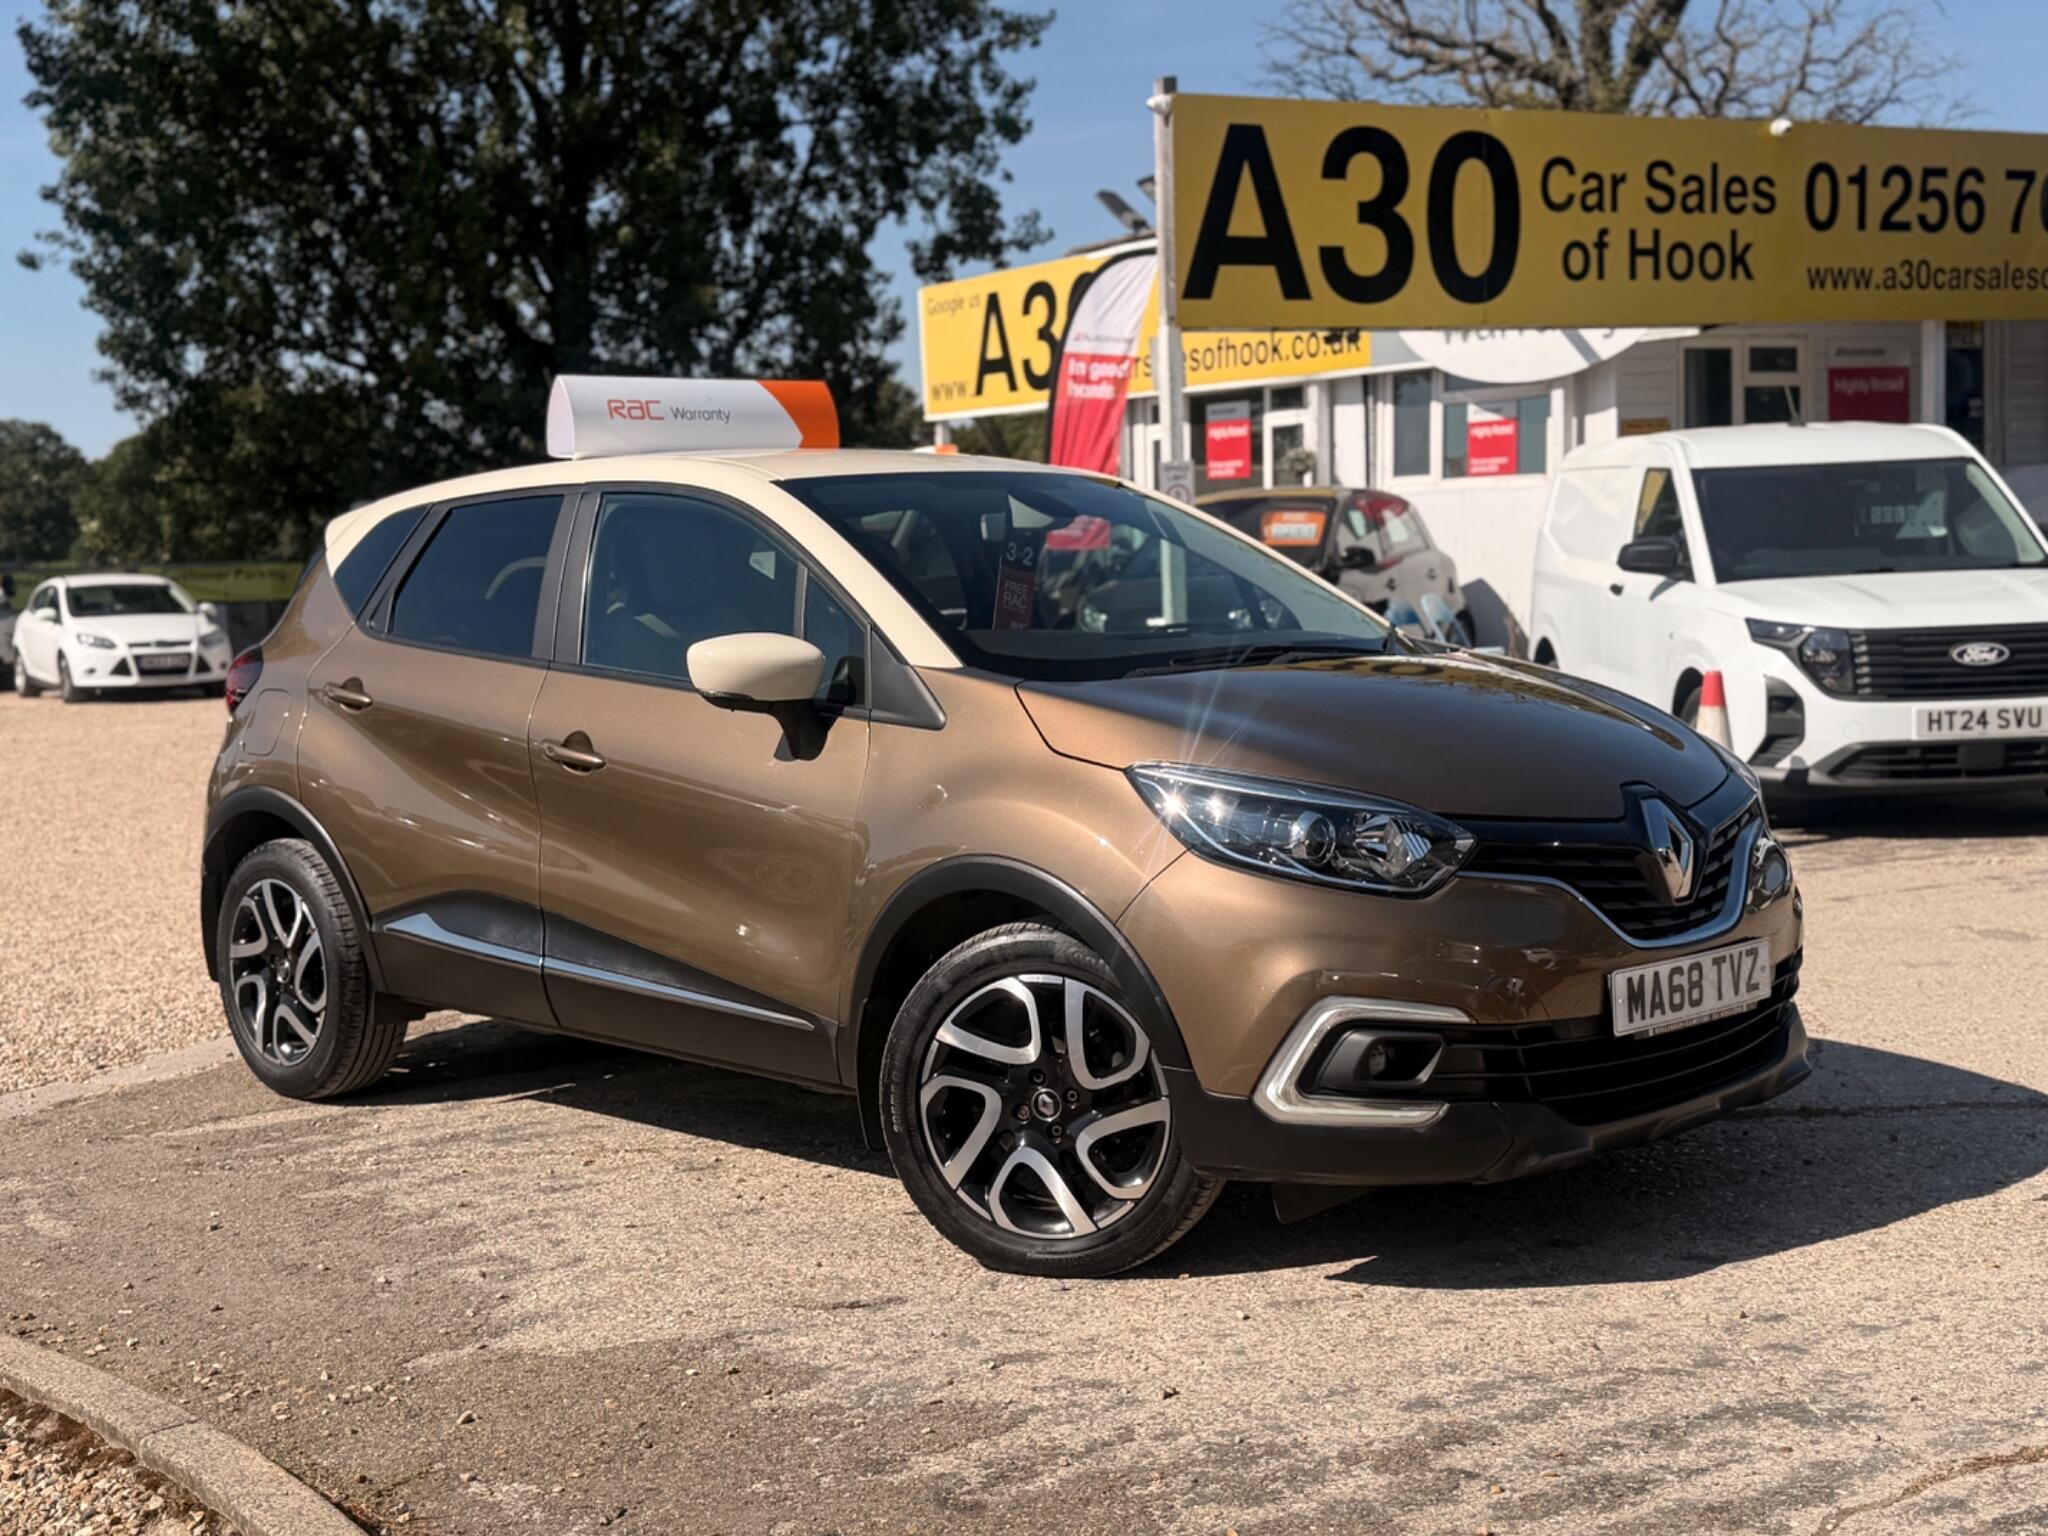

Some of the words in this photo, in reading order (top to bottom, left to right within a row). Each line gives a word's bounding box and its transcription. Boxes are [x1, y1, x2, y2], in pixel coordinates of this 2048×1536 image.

[1541, 157, 1627, 212] Car
[1646, 160, 1776, 214] Sales
[1805, 162, 1985, 233] 01256
[2005, 170, 2048, 233] 7
[1182, 123, 1521, 304] A30
[1562, 227, 1609, 281] of
[1629, 228, 1754, 281] Hook
[928, 293, 965, 317] Google
[968, 294, 981, 309] us
[670, 407, 730, 425] Warranty
[1006, 542, 1017, 561] 3
[1022, 547, 1033, 566] 2
[1003, 591, 1028, 609] RAC
[1004, 580, 1029, 594] FREE
[1927, 710, 1989, 732] HT24
[1996, 706, 2042, 730] SVU
[1626, 961, 1704, 1024] MA68
[1712, 947, 1760, 1001] TVZ
